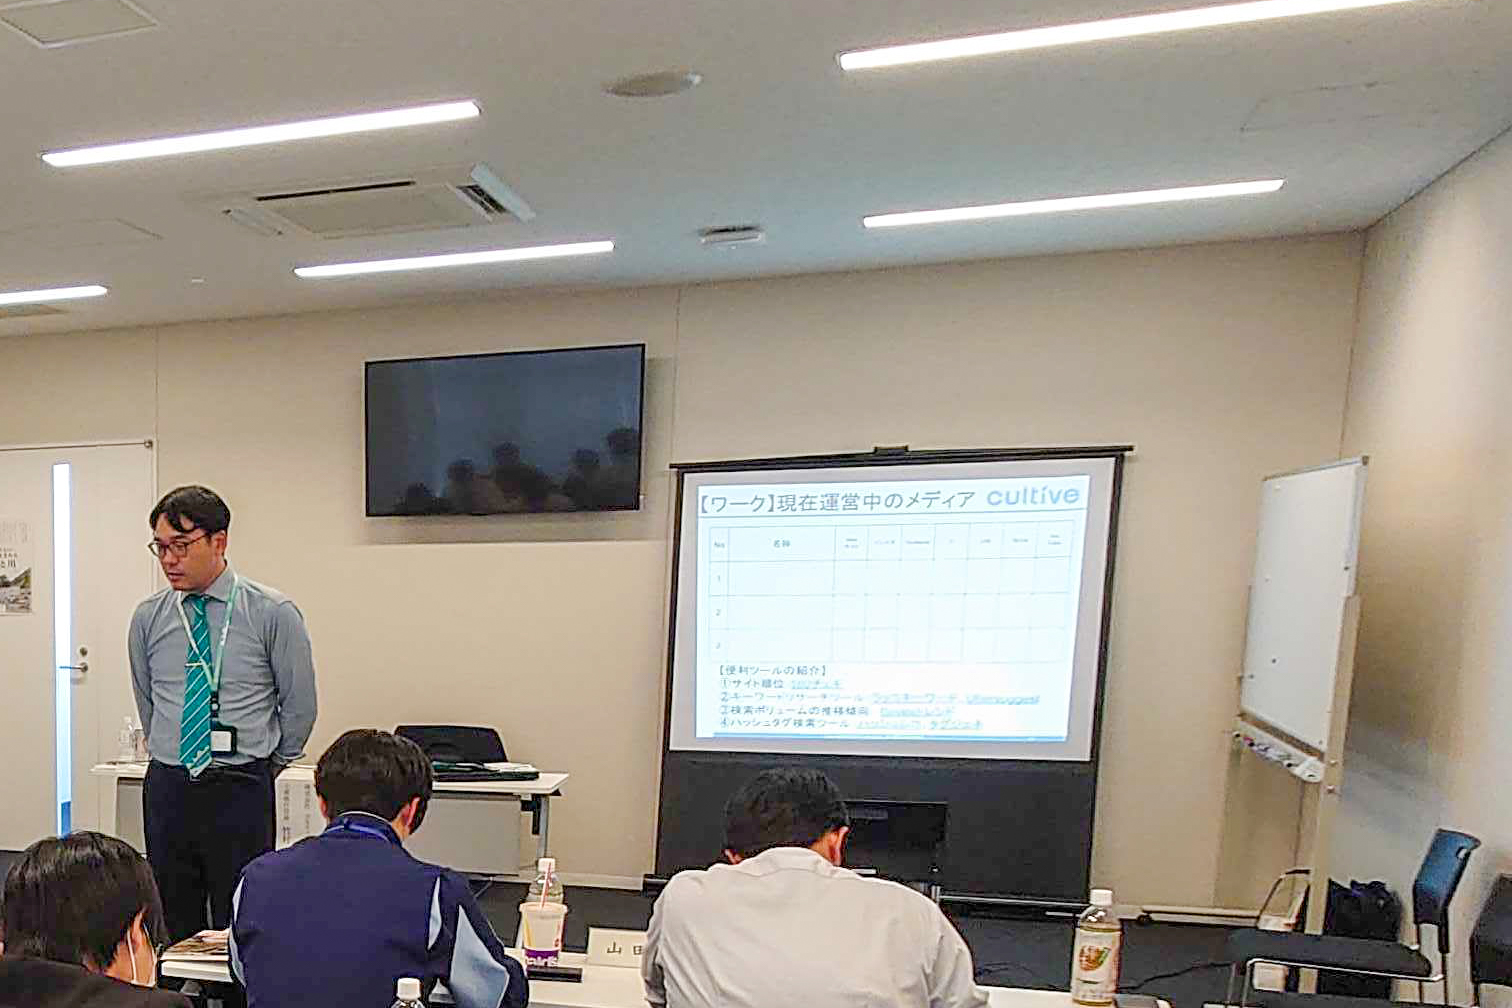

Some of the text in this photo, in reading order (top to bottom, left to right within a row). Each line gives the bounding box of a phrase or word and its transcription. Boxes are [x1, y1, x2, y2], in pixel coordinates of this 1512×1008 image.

[701, 491, 976, 513] 【ワーク】現在運営中のメディア
[986, 485, 1080, 506] cultive
